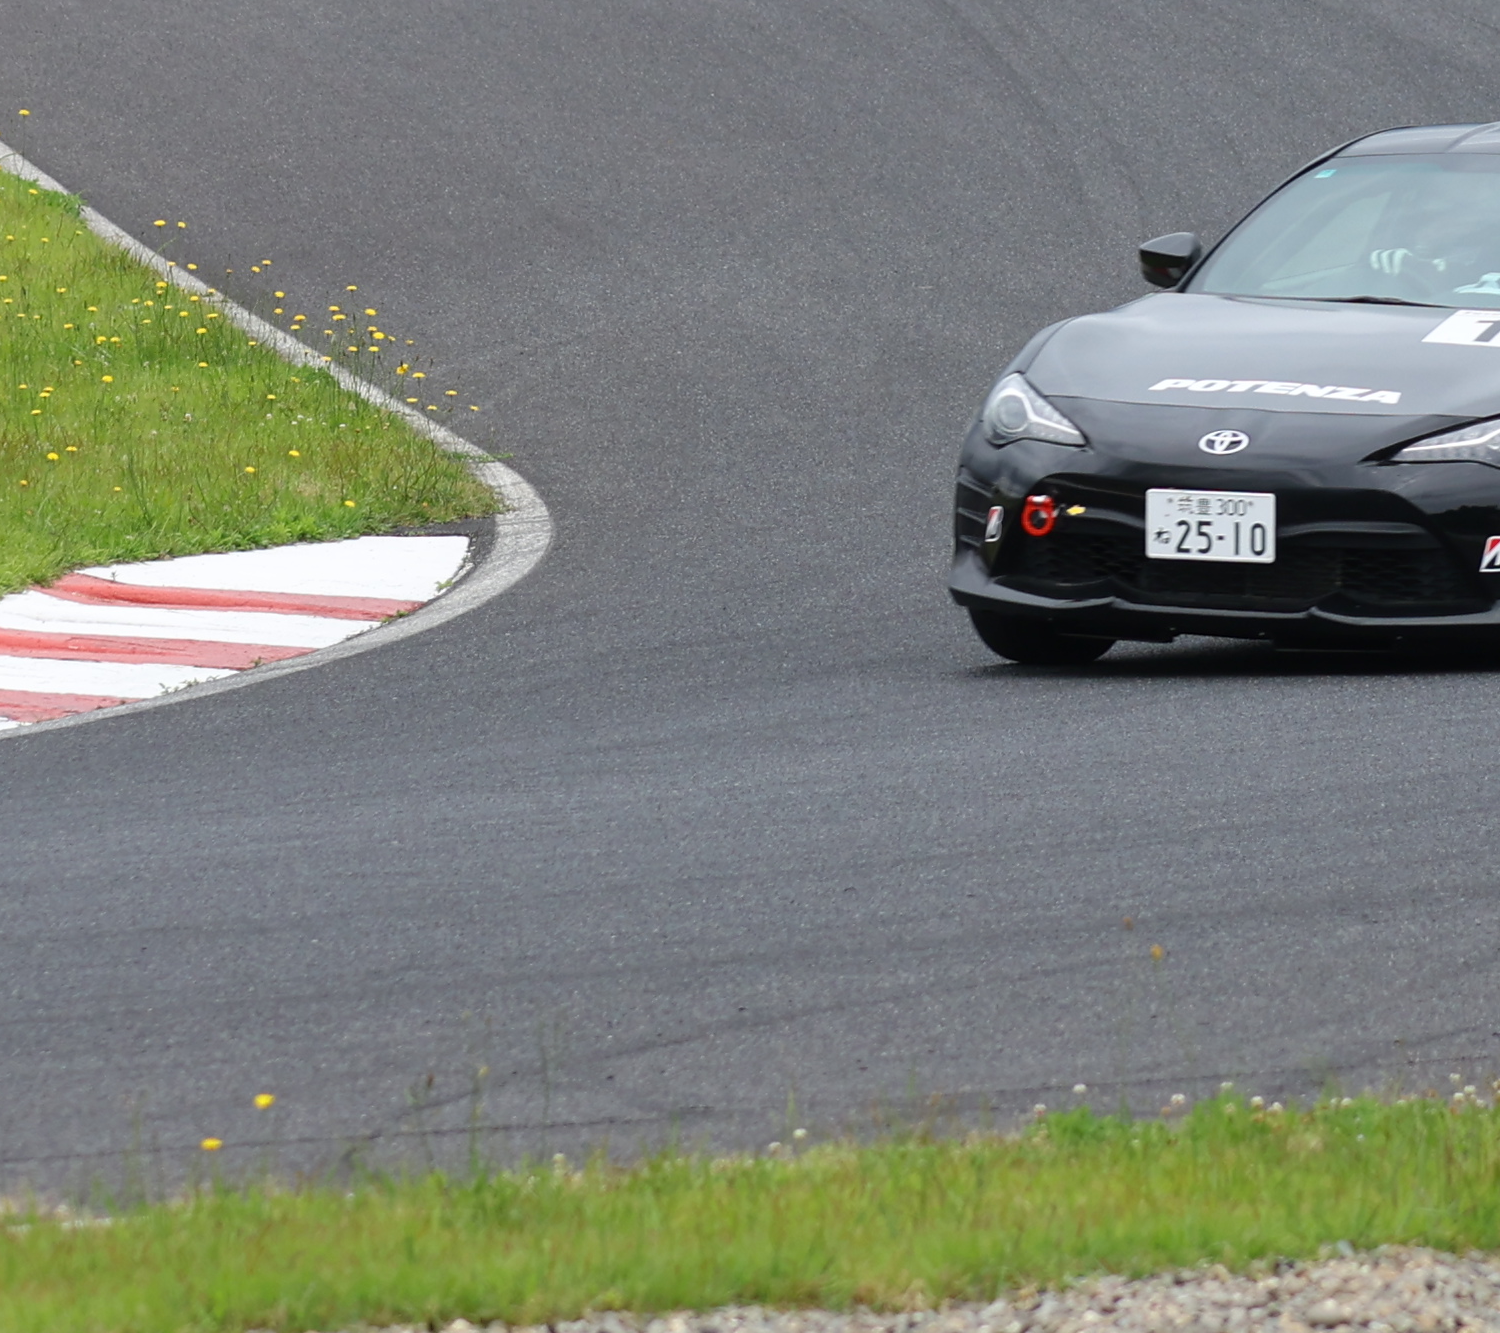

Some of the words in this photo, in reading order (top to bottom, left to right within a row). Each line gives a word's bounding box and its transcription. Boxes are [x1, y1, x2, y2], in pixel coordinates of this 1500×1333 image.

[1148, 378, 1401, 405] POTENZA
[1215, 498, 1248, 517] 300
[1175, 519, 1266, 556] 25-10
